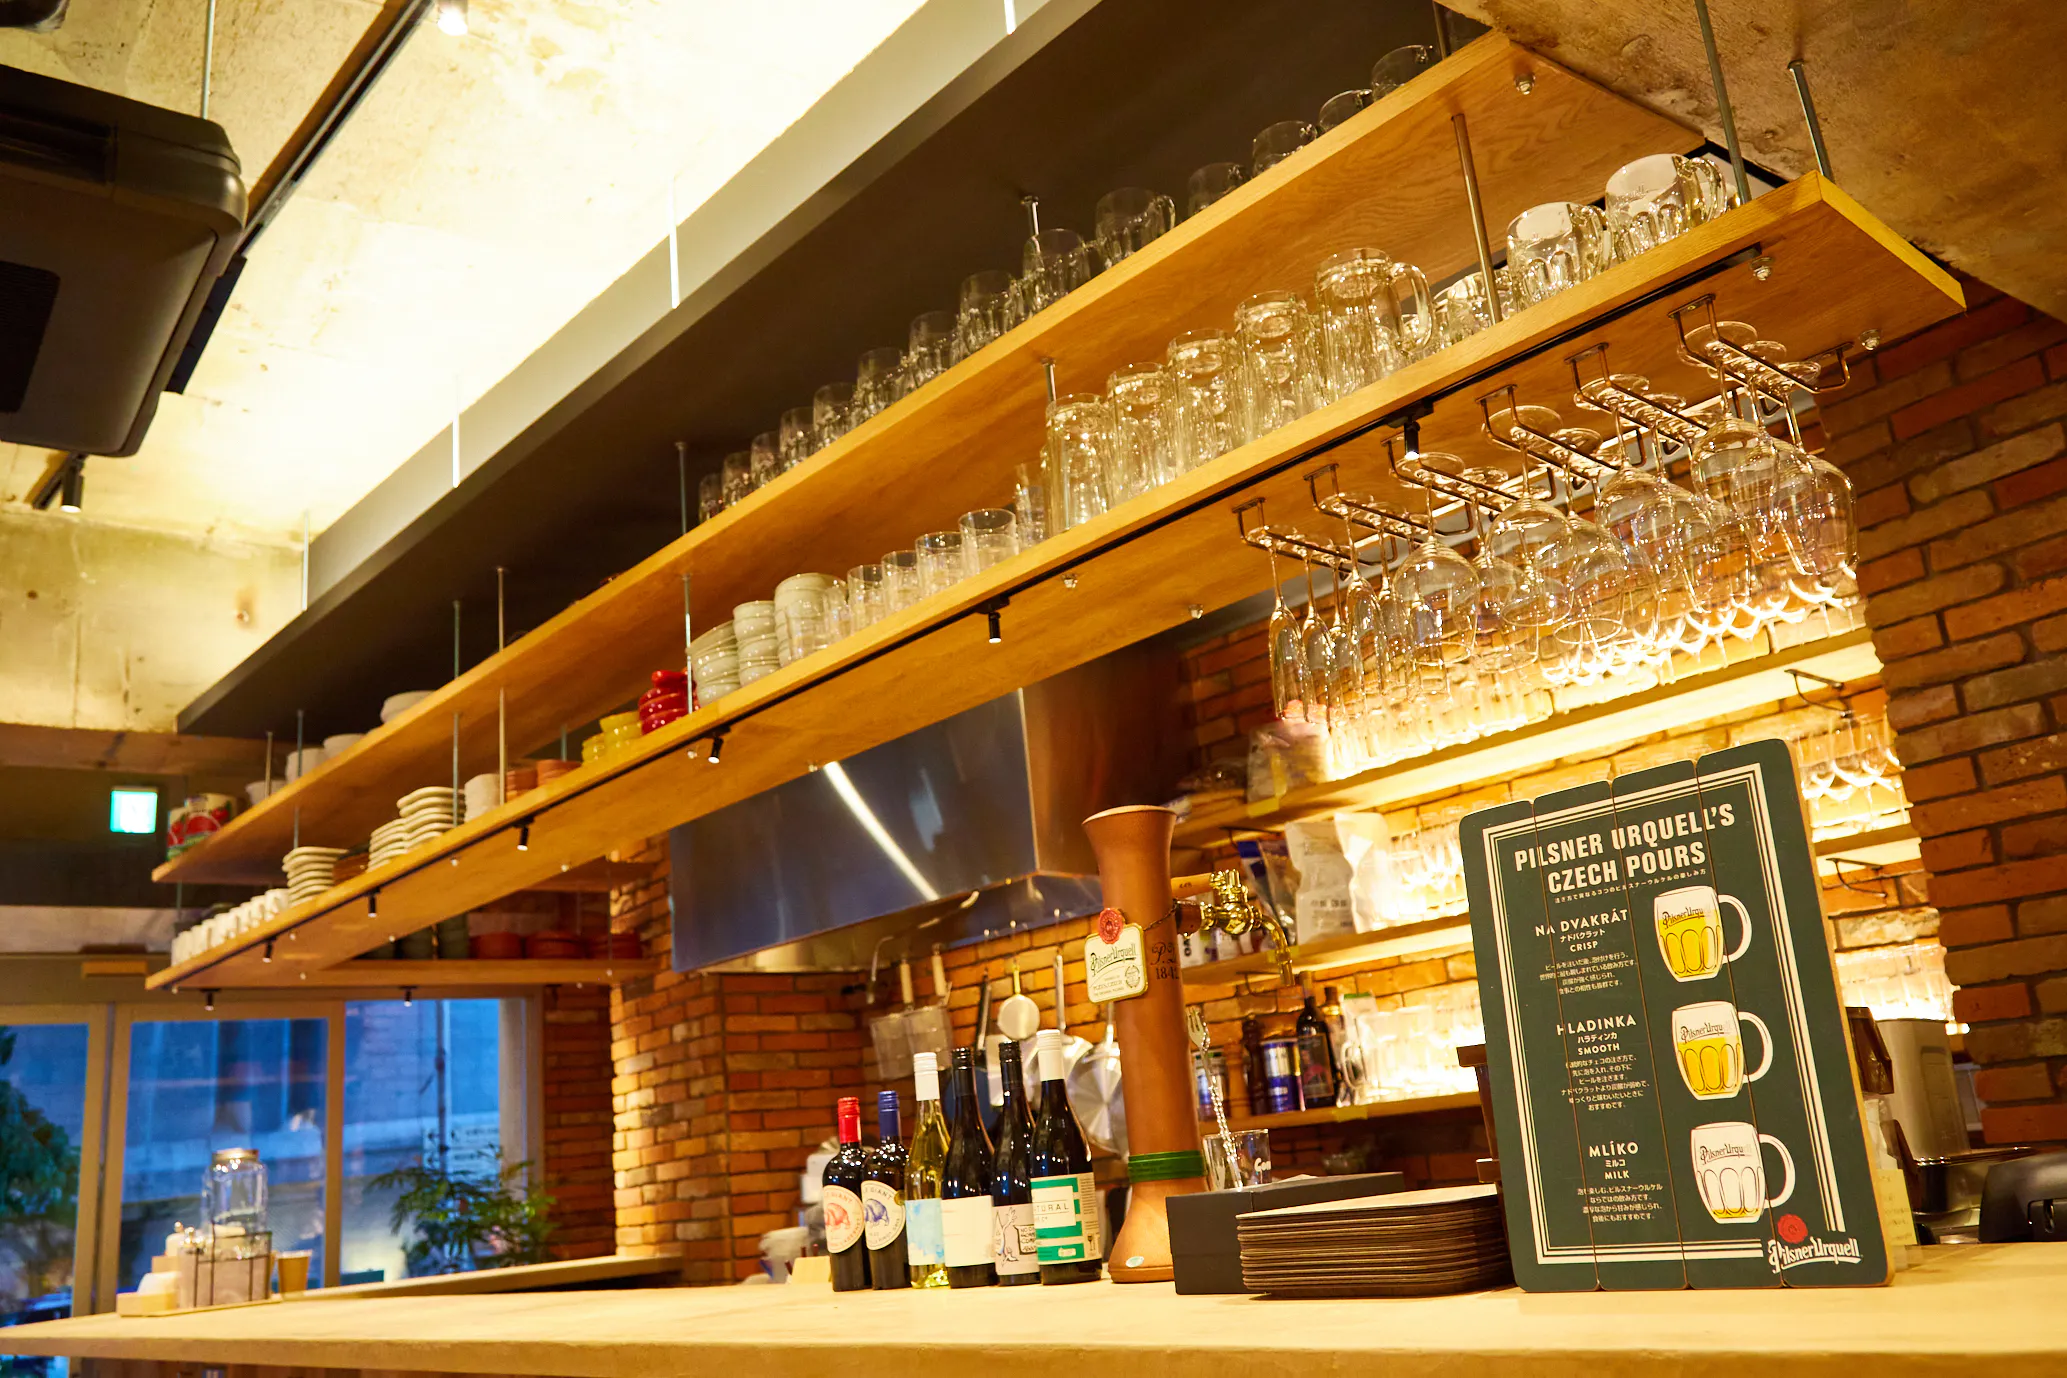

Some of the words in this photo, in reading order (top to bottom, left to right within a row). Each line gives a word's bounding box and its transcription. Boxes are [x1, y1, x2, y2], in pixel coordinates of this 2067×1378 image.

[1514, 833, 1604, 872] PILSNER
[1610, 803, 1736, 850] URQUELL'S
[1547, 859, 1618, 894] CZECH
[1625, 841, 1706, 878] POURS
[1534, 924, 1556, 937] NA
[1560, 907, 1628, 932] DVAKRÁT
[1662, 911, 1687, 930] Pilsner
[1569, 940, 1599, 953] CRISP
[1556, 1014, 1637, 1036] HLADINKA
[1680, 1025, 1706, 1044] Pilsner
[1577, 1031, 1618, 1044] ハラディンカ
[1577, 1043, 1620, 1056] SMOOTH
[1589, 1140, 1639, 1158] MLÍKO
[1699, 1145, 1726, 1165] Pilsner
[1605, 1159, 1626, 1168] ミルコ
[1604, 1170, 1630, 1180] MILK
[1767, 1238, 1815, 1274] Pilsner
[1810, 1236, 1860, 1265] Urquell
